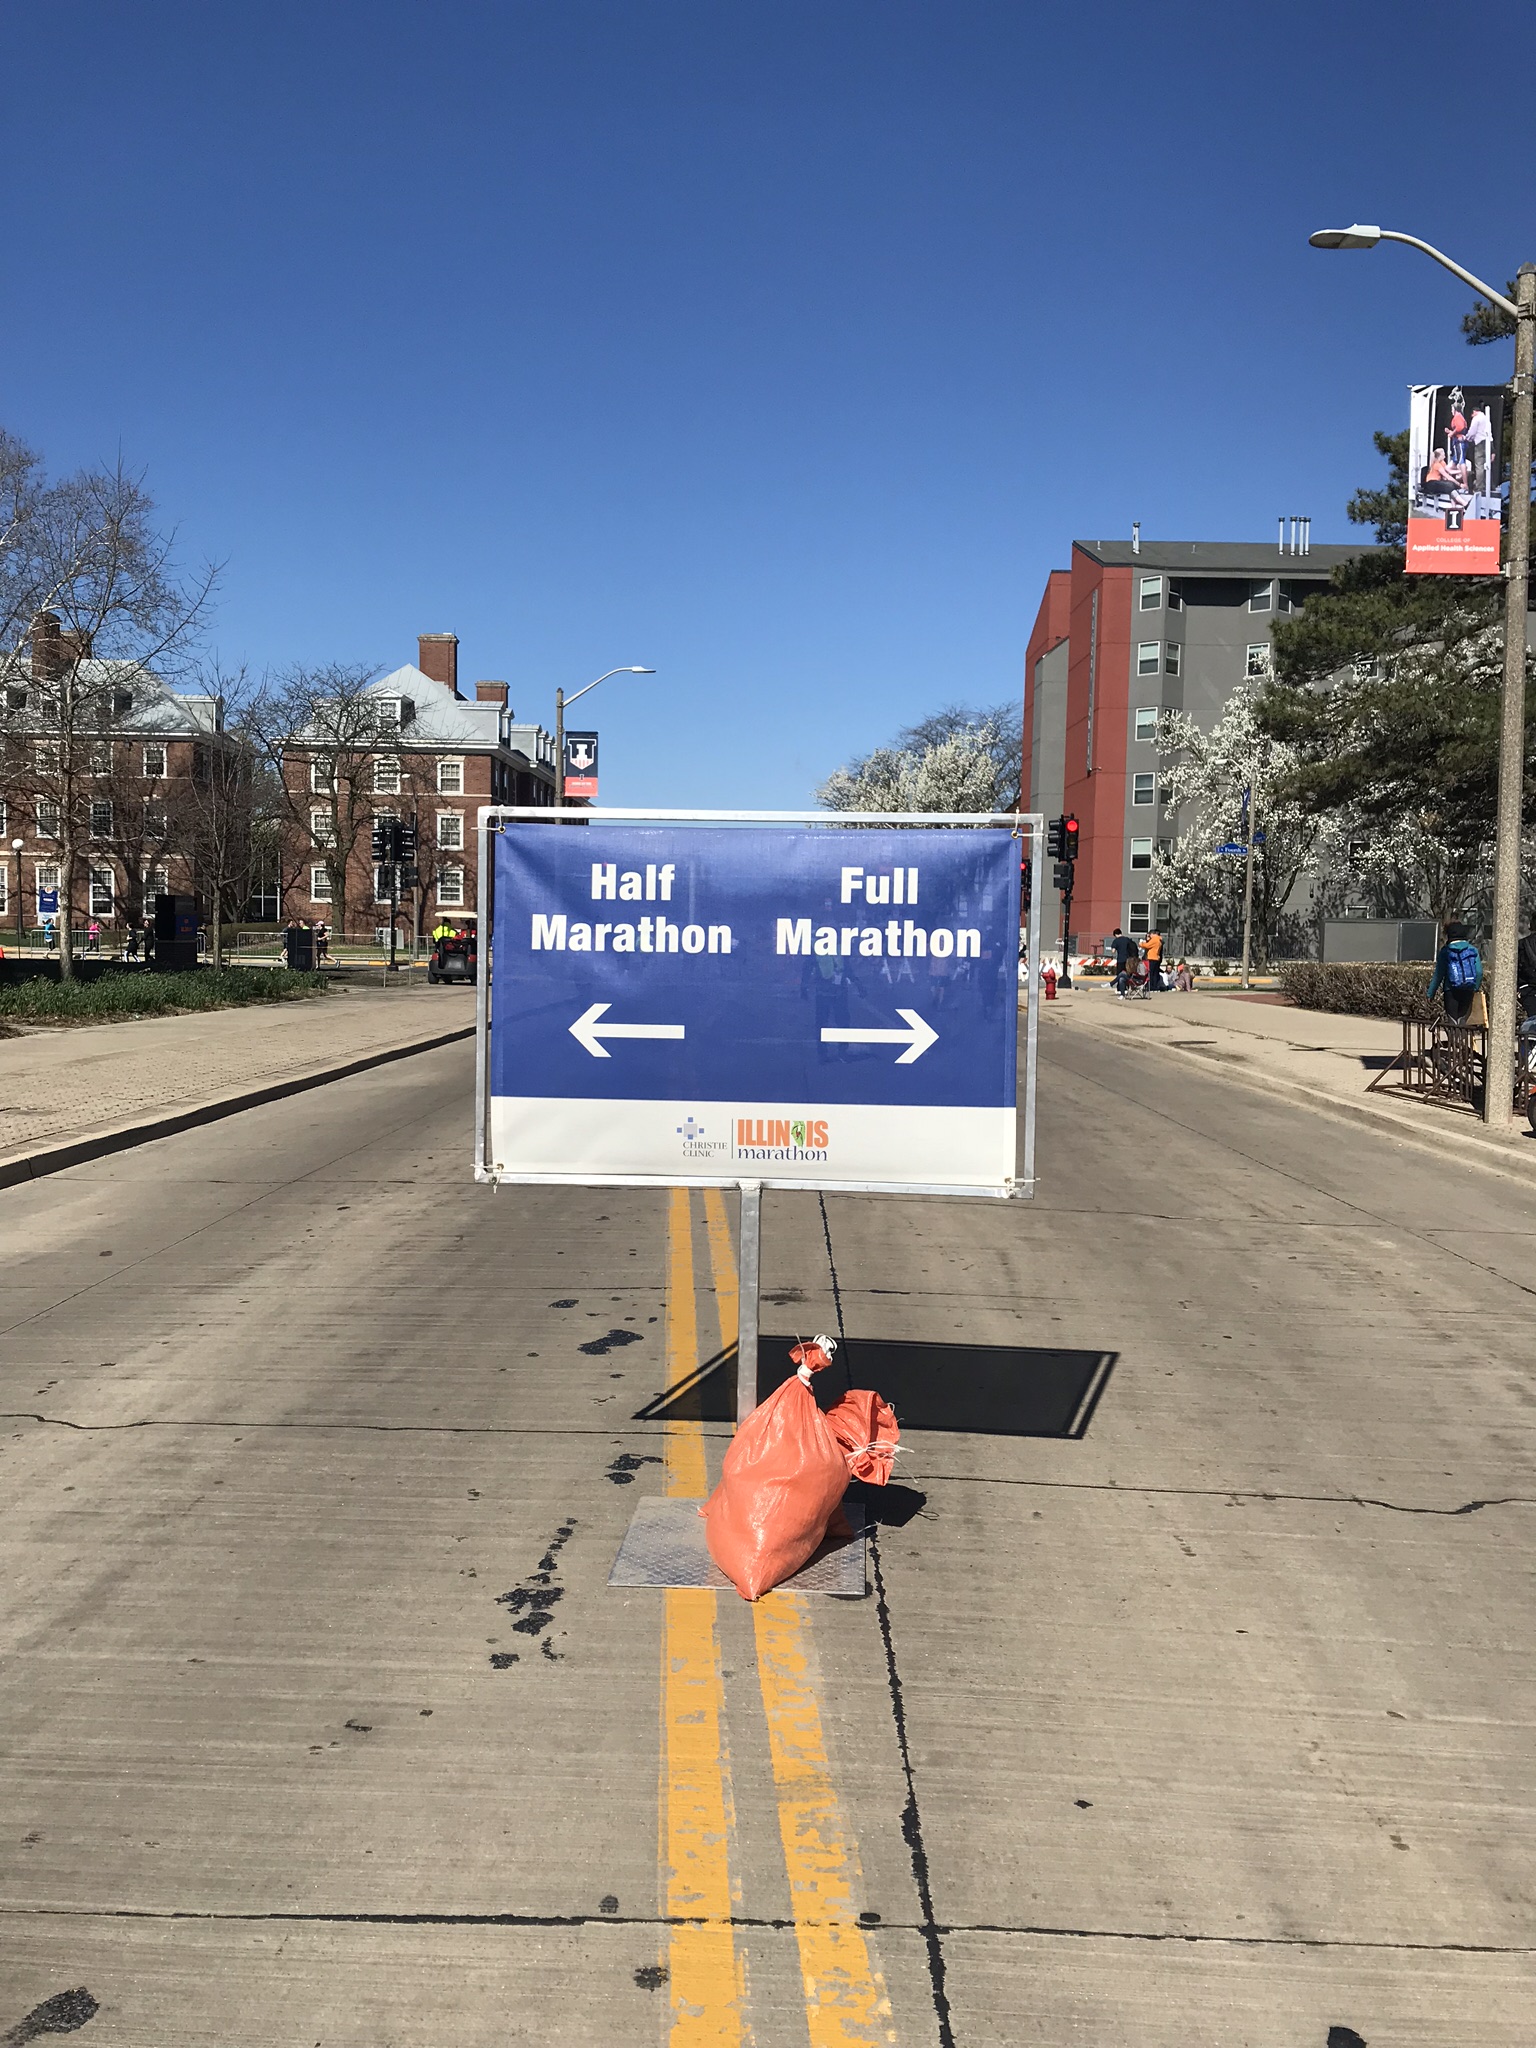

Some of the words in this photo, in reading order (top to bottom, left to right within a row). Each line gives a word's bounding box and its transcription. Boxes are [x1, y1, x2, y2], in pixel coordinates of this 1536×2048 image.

[1412, 544, 1440, 552] Applied
[1440, 544, 1464, 552] Health
[591, 863, 676, 901] Half
[840, 866, 919, 905] Full
[531, 913, 732, 954] Marathon
[776, 918, 981, 958] Marathon
[683, 1141, 728, 1150] CHRISTIE
[683, 1149, 715, 1158] CLINIC
[738, 1145, 828, 1162] marathon
